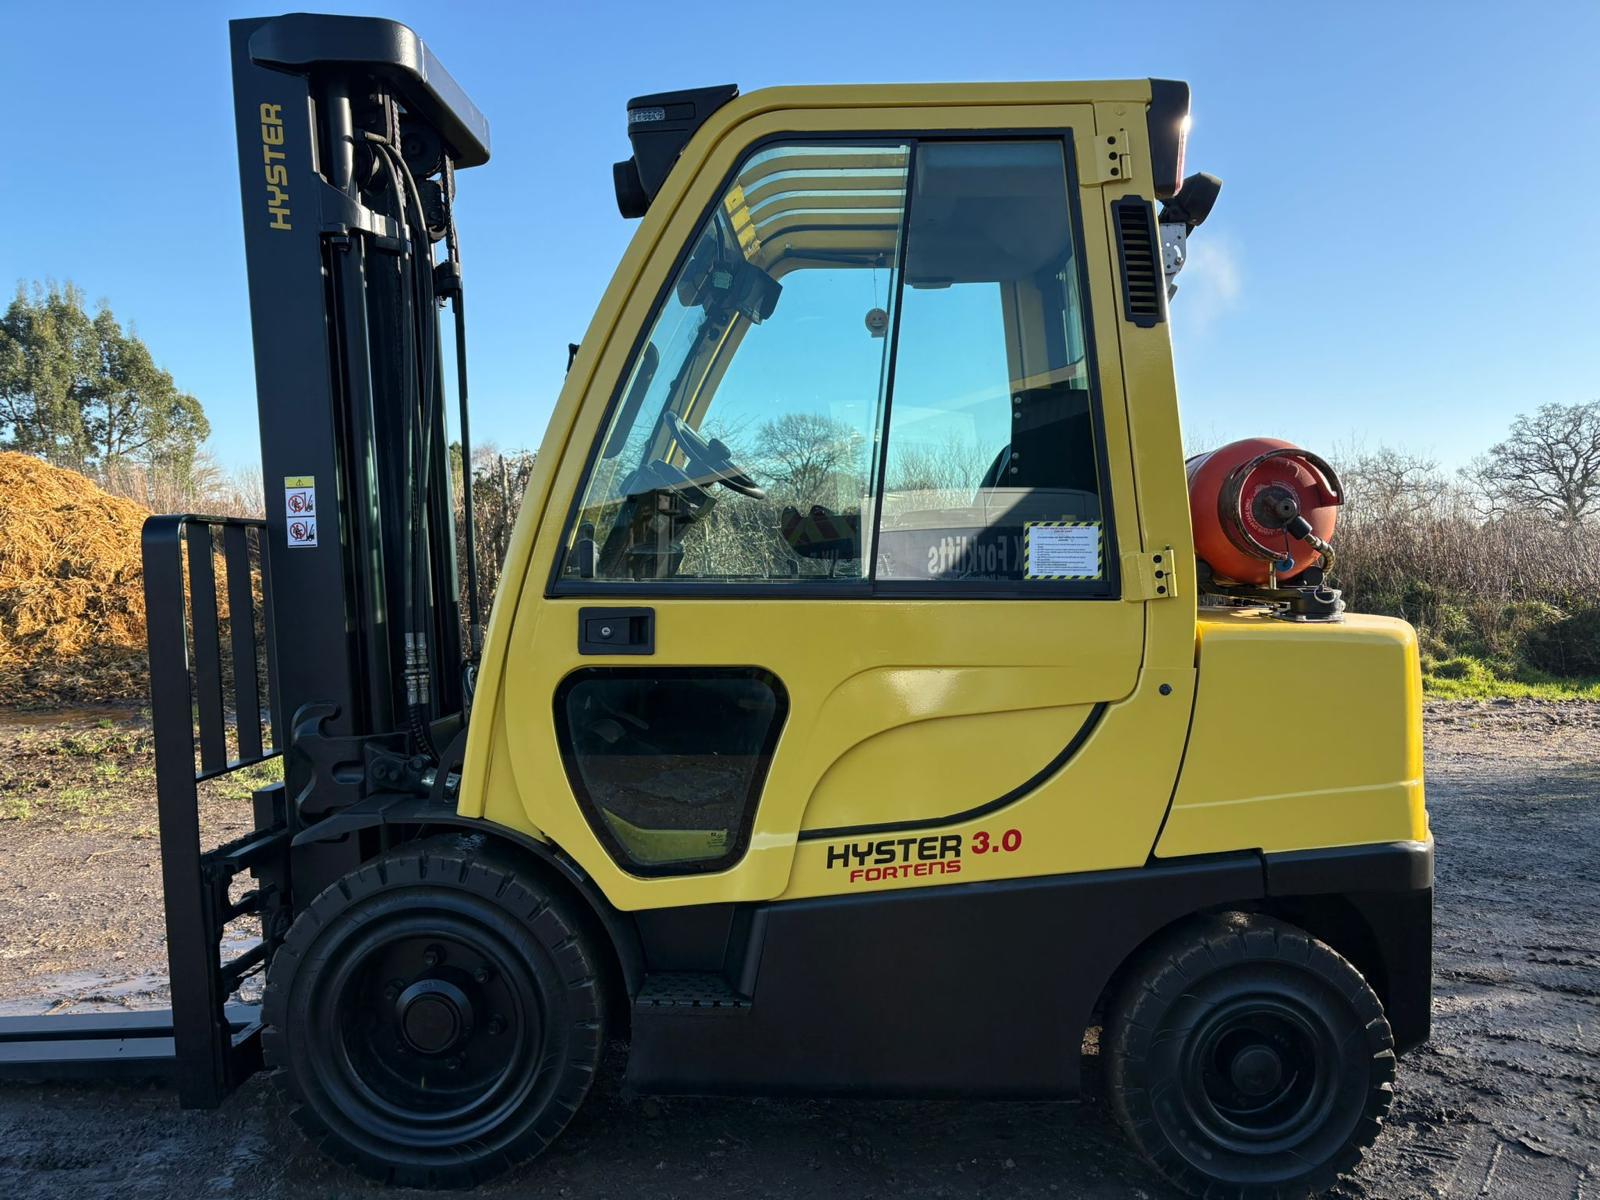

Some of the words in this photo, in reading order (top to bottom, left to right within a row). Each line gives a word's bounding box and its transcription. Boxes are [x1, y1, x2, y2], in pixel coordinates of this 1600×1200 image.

[260, 103, 292, 230] HYSTER
[826, 834, 962, 869] HYSTER
[971, 829, 1022, 854] 3.0
[850, 860, 961, 883] FORTENS
